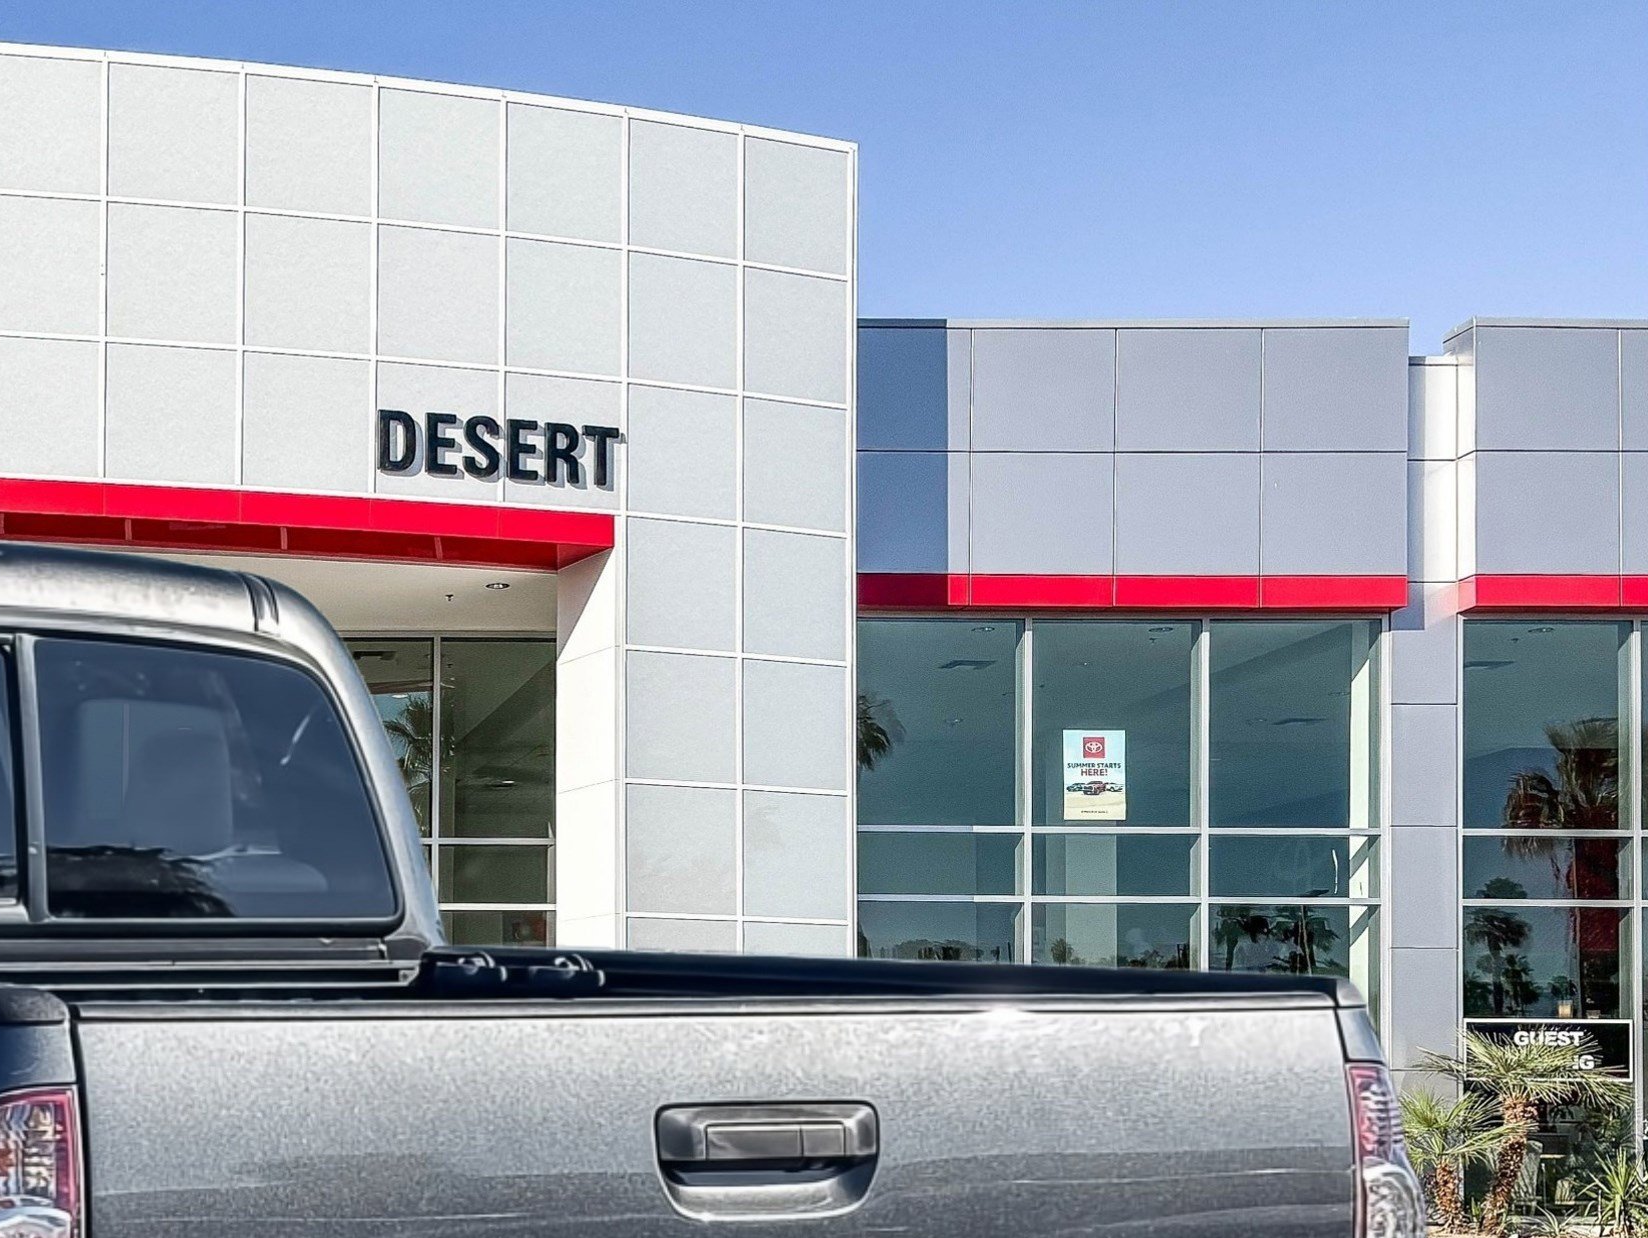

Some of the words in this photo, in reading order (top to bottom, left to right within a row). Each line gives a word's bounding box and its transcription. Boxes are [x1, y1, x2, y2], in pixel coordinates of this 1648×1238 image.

[377, 409, 620, 487] DESERT
[1080, 768, 1108, 777] HERE!
[1514, 1030, 1584, 1047] GUEST
